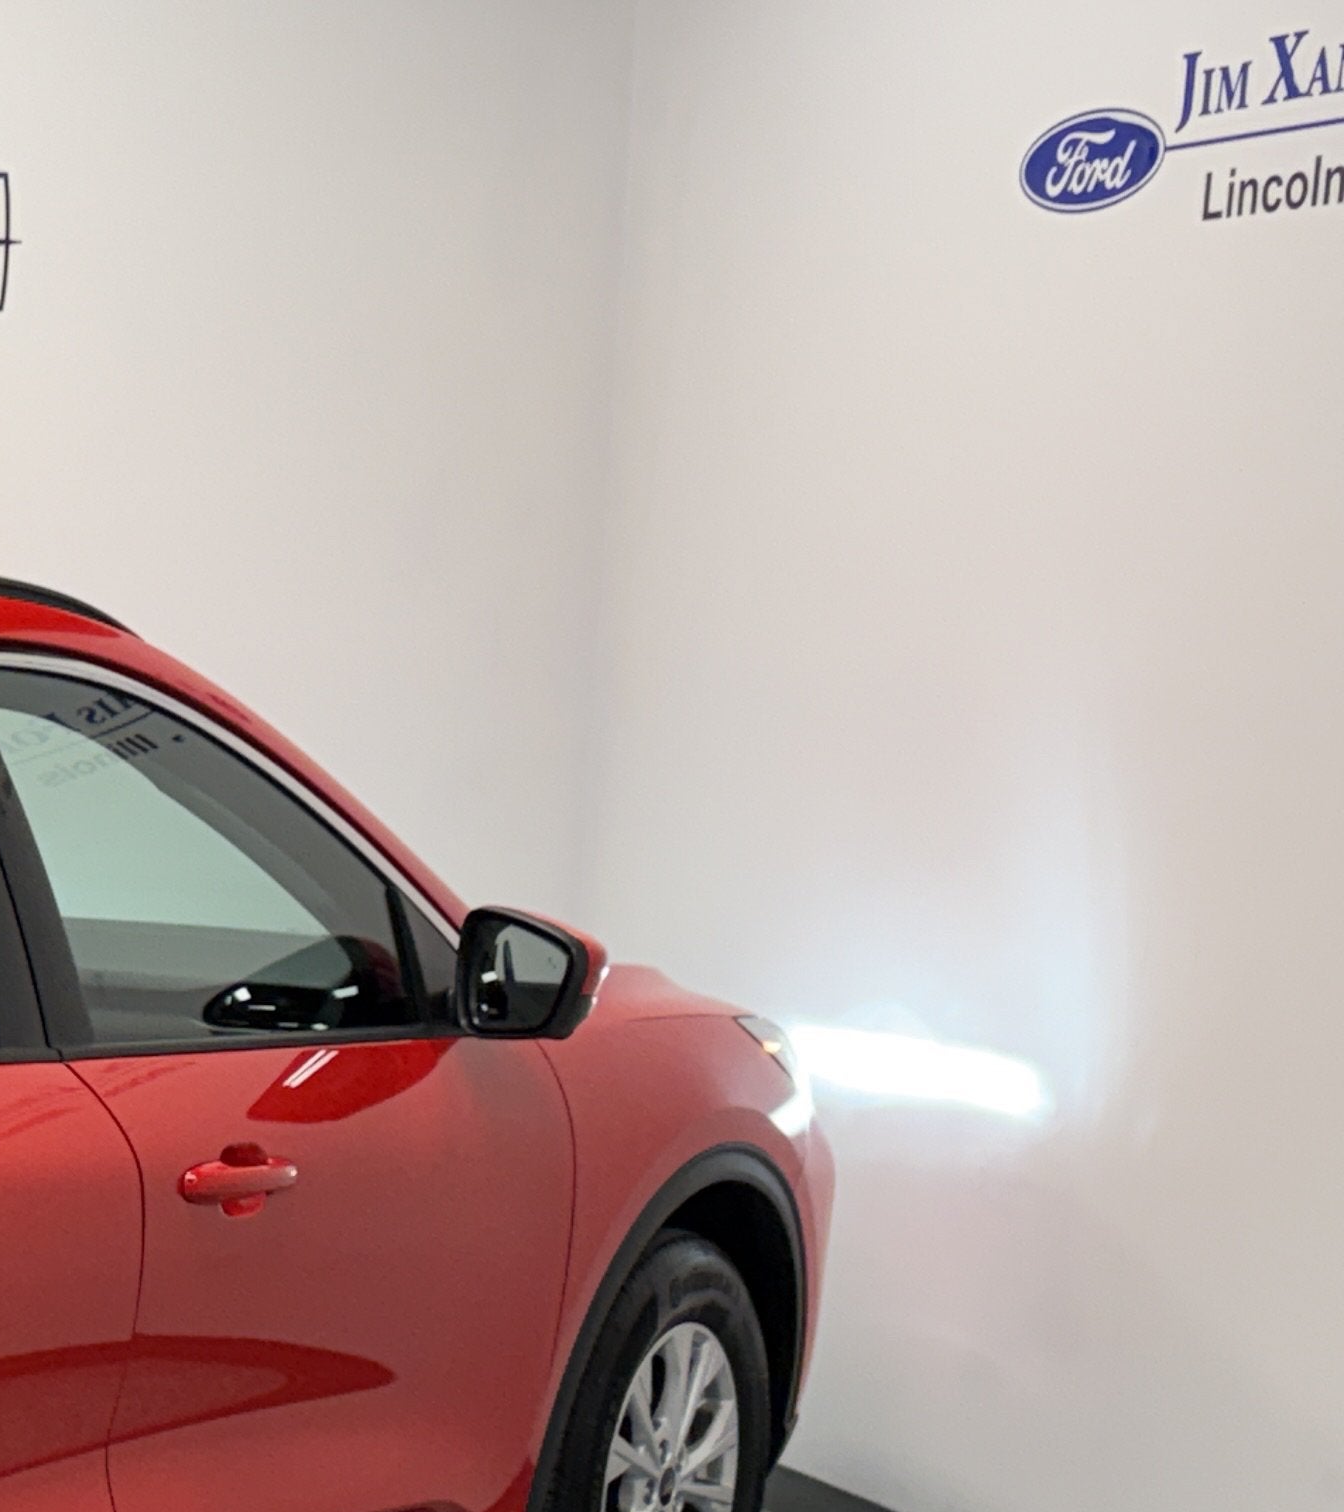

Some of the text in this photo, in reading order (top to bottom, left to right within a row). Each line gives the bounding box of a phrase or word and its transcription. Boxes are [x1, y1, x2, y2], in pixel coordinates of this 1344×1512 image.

[1175, 30, 1344, 134] JIM XA
[1044, 128, 1137, 198] Ford
